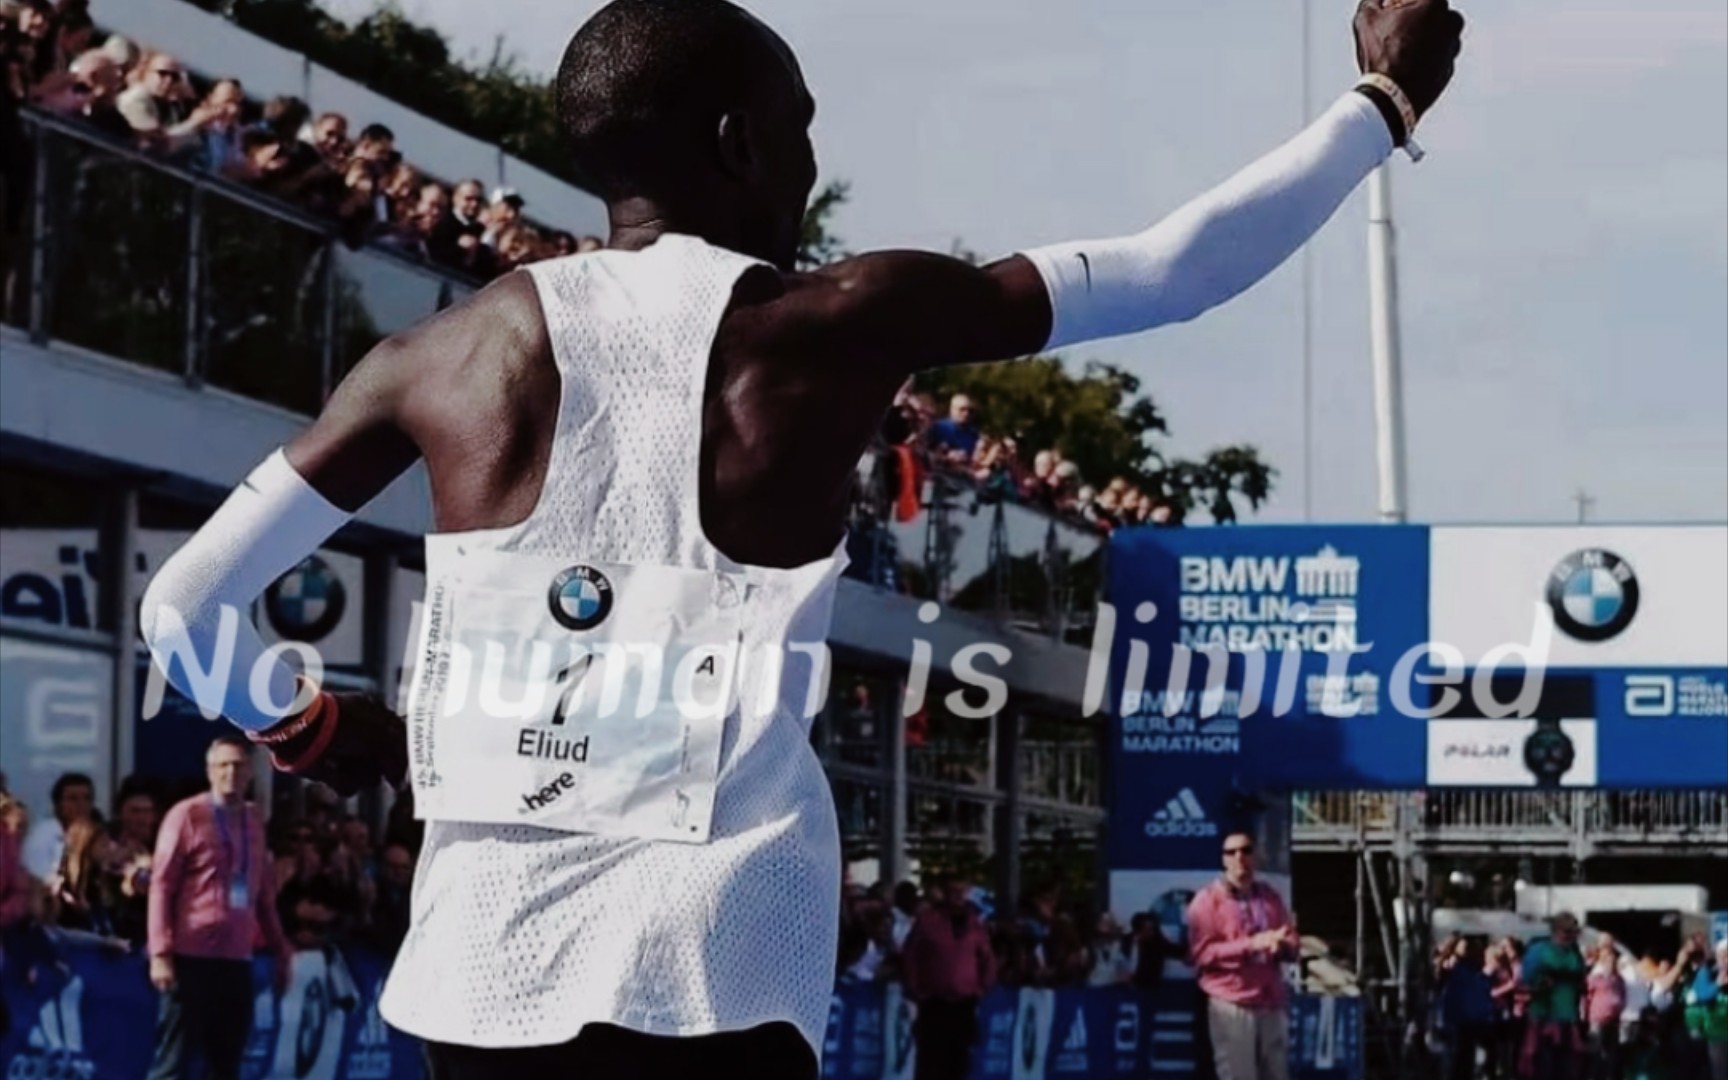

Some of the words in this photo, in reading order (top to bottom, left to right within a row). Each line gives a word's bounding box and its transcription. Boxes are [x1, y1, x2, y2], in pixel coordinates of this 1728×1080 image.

[1180, 556, 1289, 592] BMW
[1180, 596, 1290, 621] BERLIN
[1180, 626, 1357, 651] MARATHON
[696, 655, 715, 675] A
[552, 653, 593, 725] 1
[1123, 690, 1195, 713] BMW
[1123, 717, 1195, 732] BERLIN
[518, 728, 590, 762] Eliud
[1123, 735, 1239, 752] MARATHON
[521, 772, 575, 810] here
[1144, 820, 1218, 837] adidas
